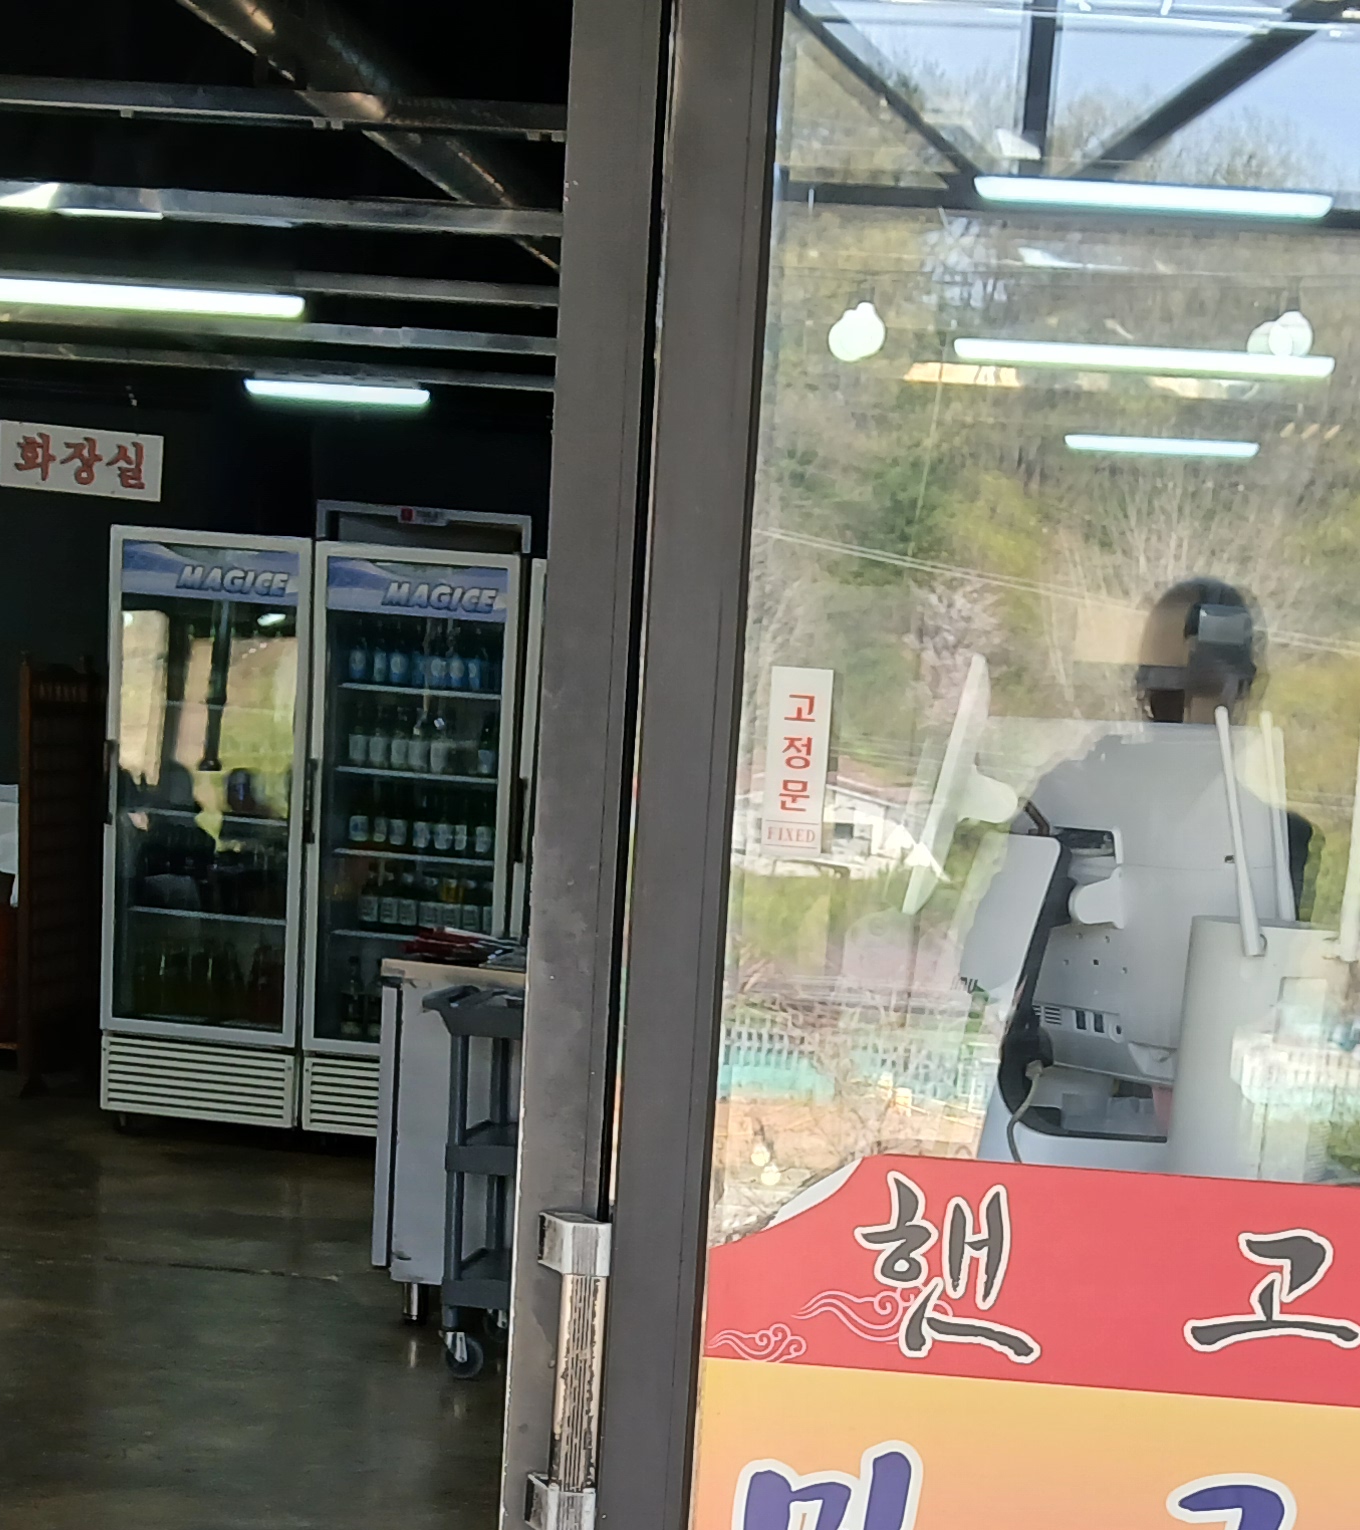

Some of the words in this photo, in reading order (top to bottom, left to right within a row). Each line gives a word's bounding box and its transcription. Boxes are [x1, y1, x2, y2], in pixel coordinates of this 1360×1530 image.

[14, 432, 145, 489] 화장실
[175, 564, 290, 598] MAGICE
[381, 581, 499, 614] MAGICE
[779, 694, 816, 812] 고정문
[766, 826, 816, 843] FIXED
